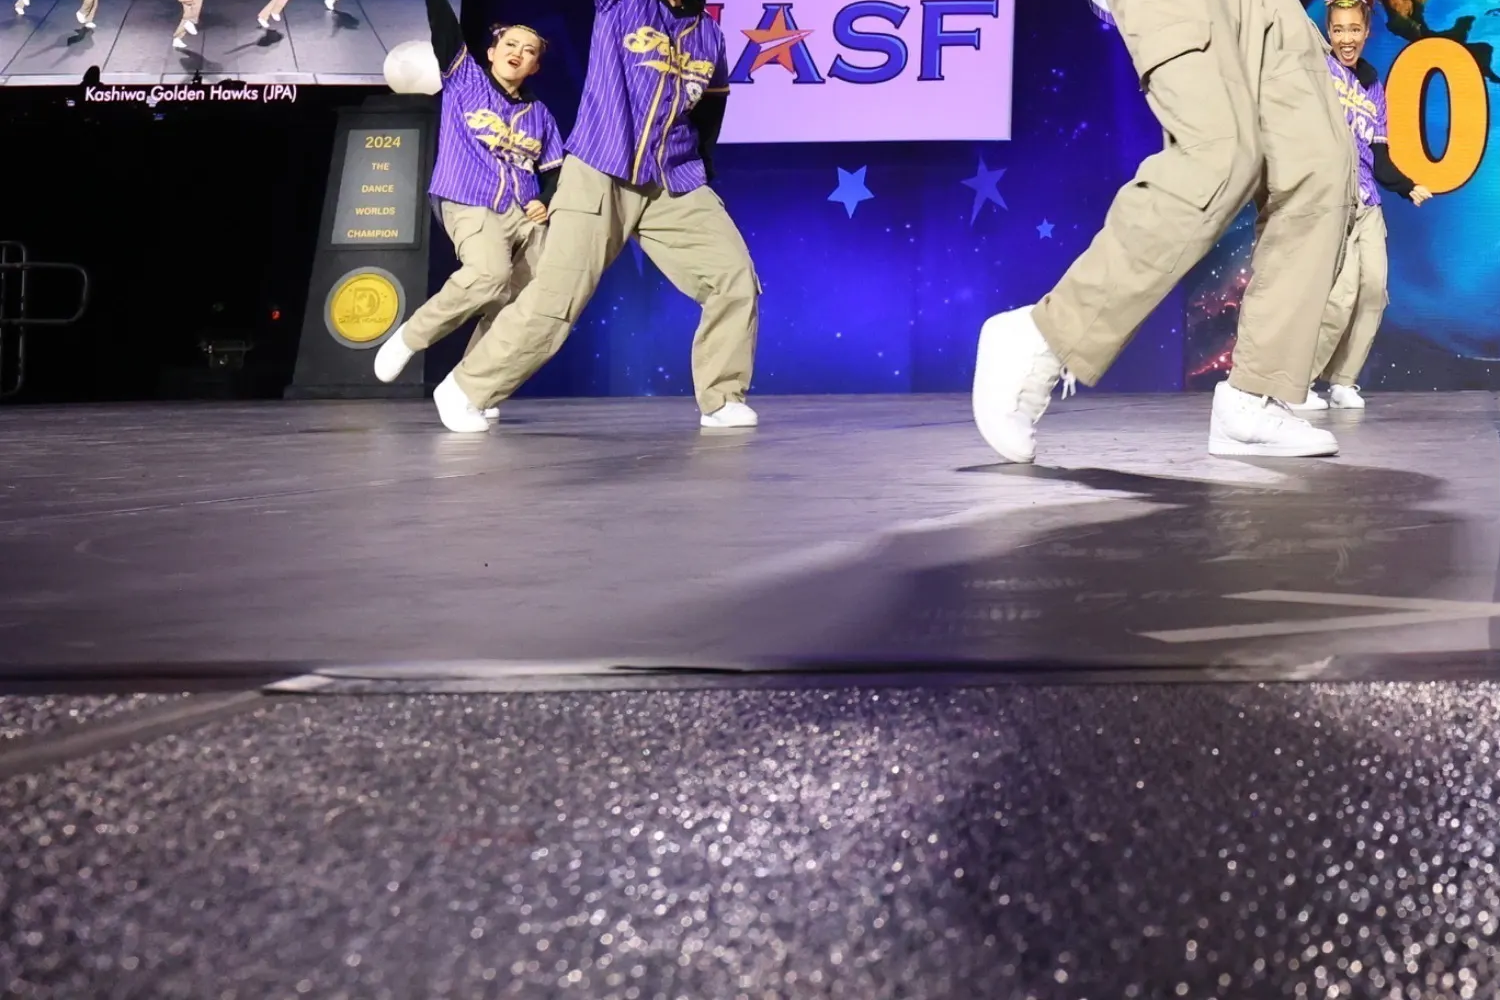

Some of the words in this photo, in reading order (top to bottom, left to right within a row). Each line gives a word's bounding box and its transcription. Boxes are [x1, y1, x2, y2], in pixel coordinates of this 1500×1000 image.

[85, 86, 146, 102] Kashiwa
[150, 85, 205, 101] Golden
[209, 85, 259, 101] Hawks
[263, 84, 297, 103] (JPA)
[365, 135, 401, 149] 2024
[371, 162, 391, 171] THE
[361, 184, 395, 193] DANCE
[355, 206, 396, 216] WORLDS
[347, 229, 399, 239] CHAMPION
